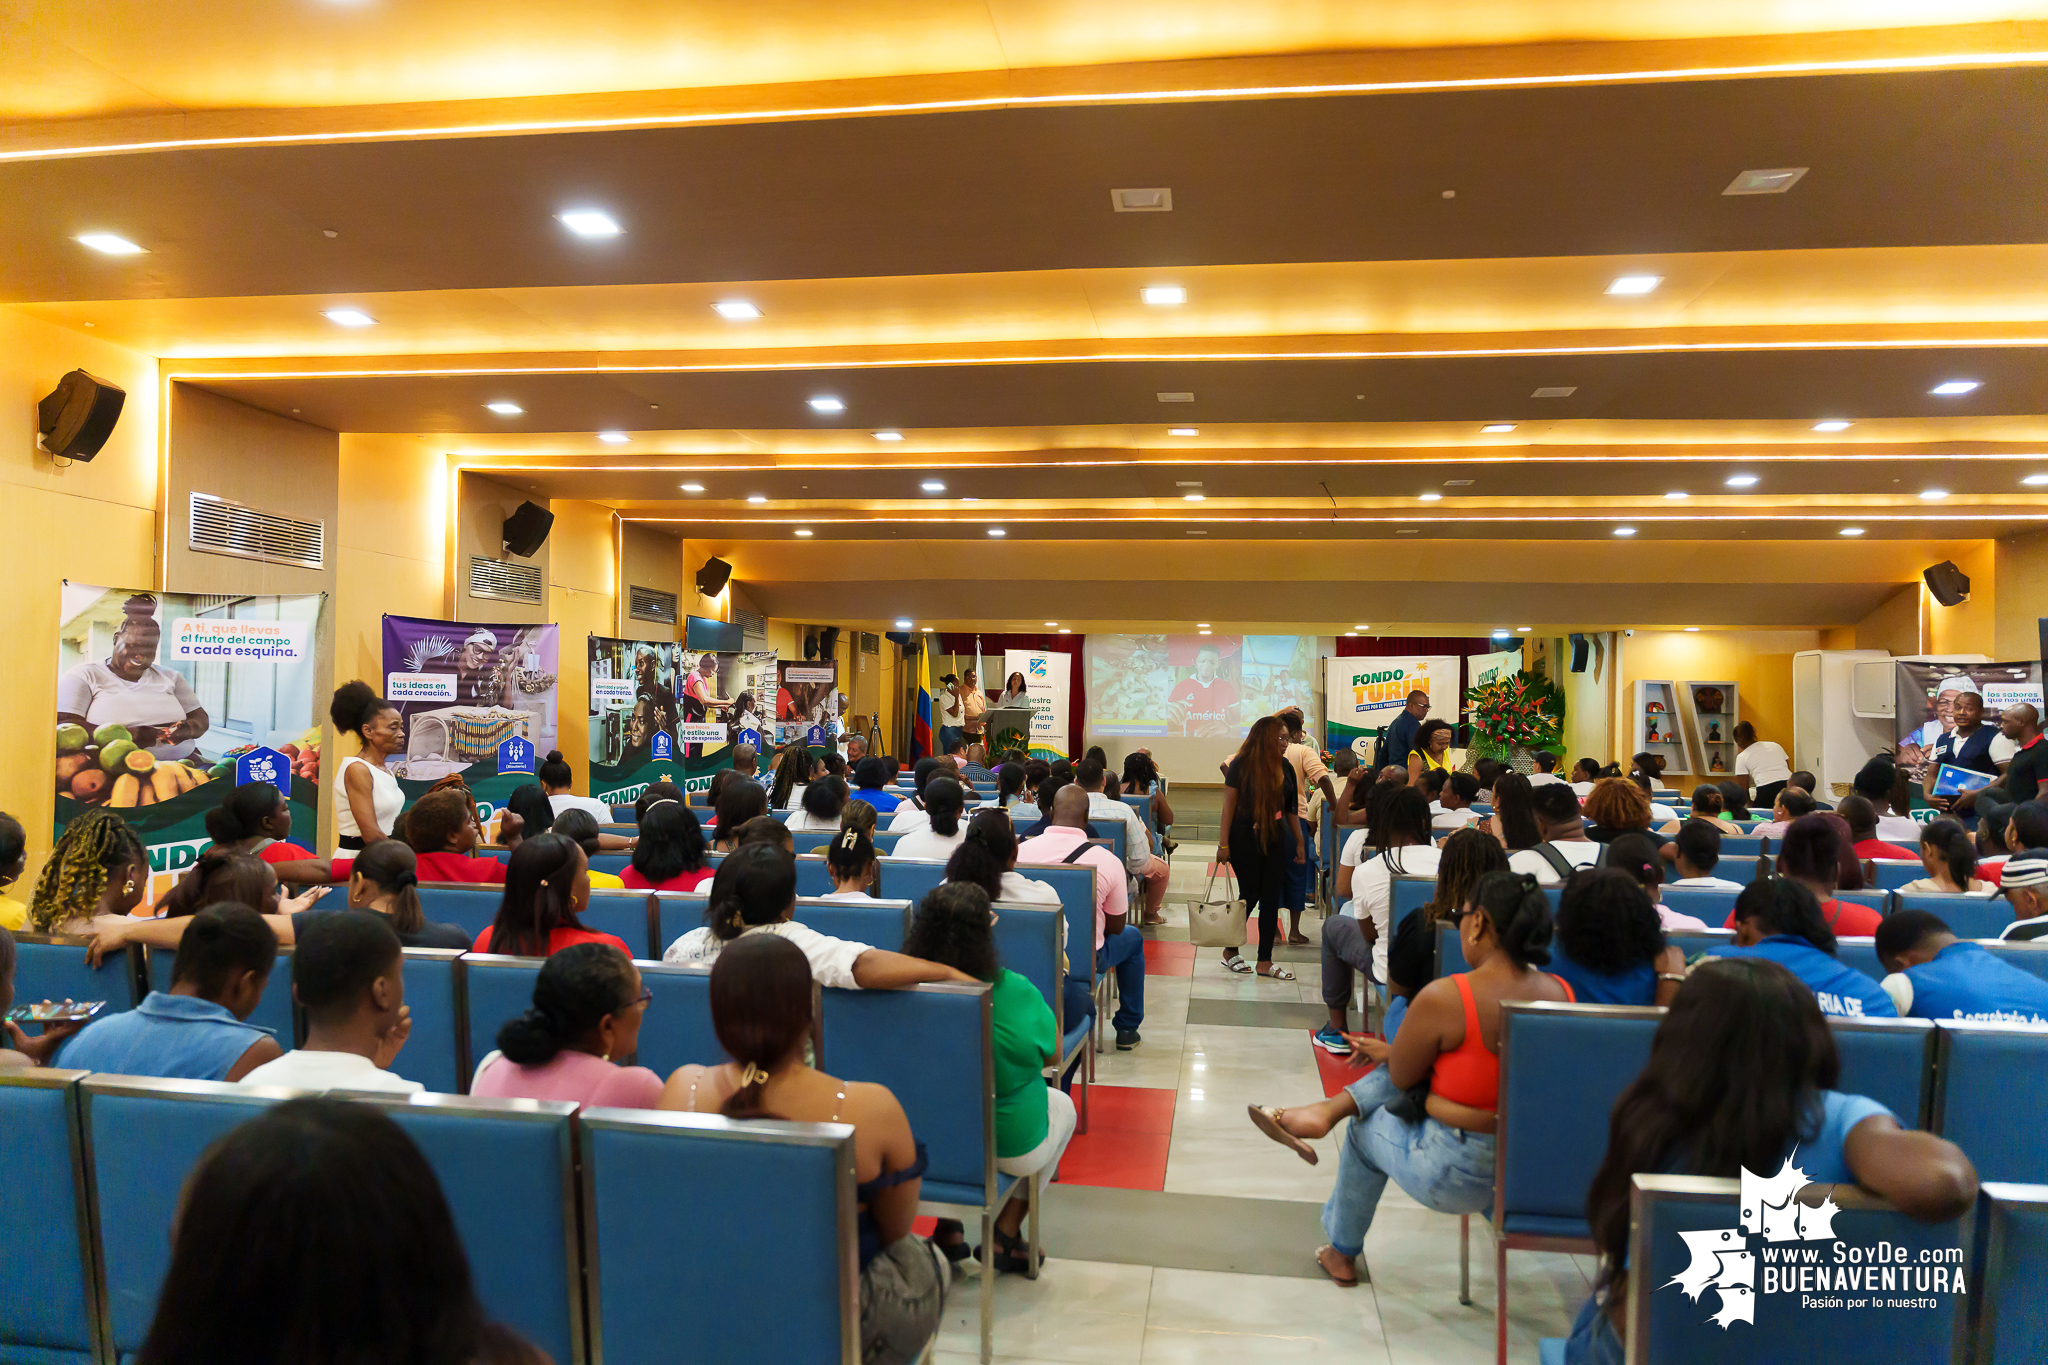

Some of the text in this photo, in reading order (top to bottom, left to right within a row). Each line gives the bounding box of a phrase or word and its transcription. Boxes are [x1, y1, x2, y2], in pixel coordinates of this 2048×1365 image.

[183, 623, 280, 636] A ti, que llevas
[181, 634, 291, 647] el fruto del campo
[181, 645, 297, 659] a cada esquina.
[1352, 669, 1404, 686] FONDO
[1352, 673, 1430, 704] TURÍN
